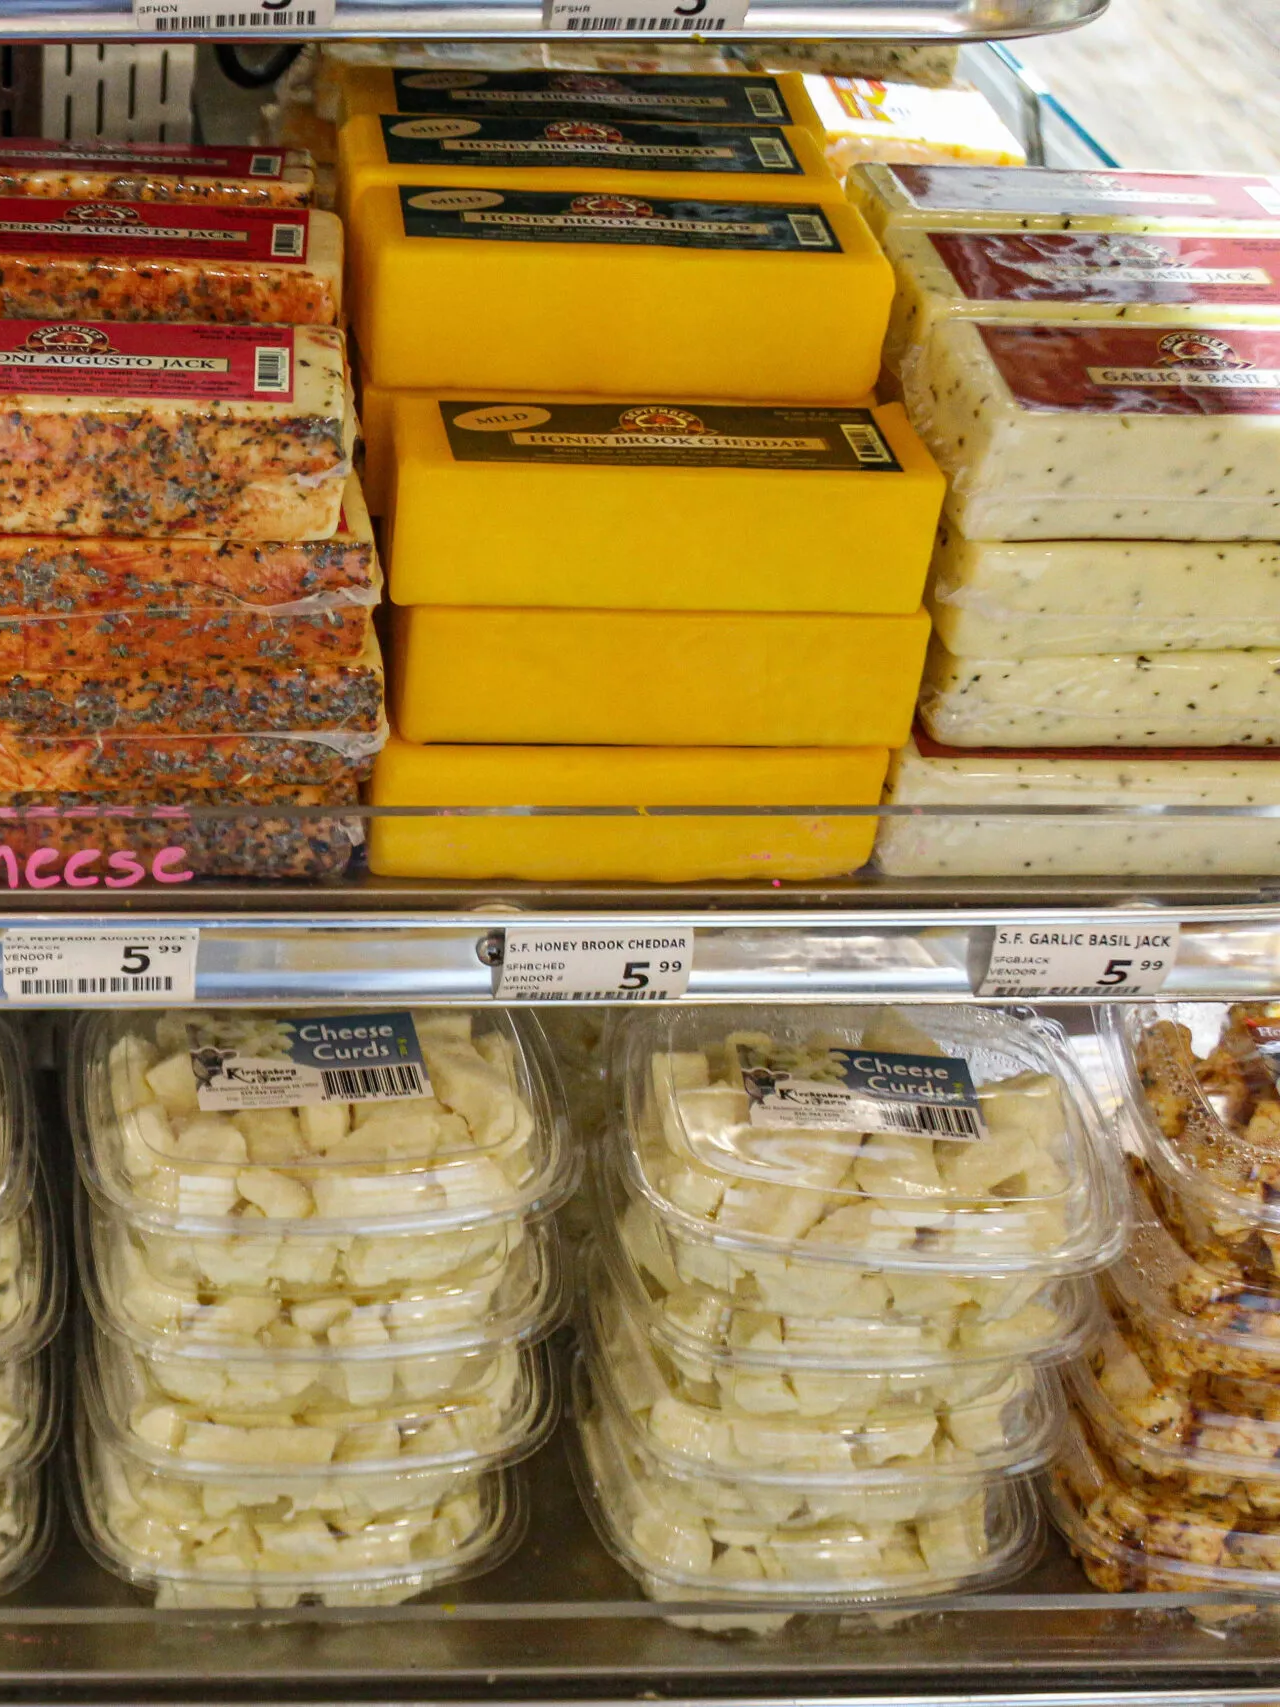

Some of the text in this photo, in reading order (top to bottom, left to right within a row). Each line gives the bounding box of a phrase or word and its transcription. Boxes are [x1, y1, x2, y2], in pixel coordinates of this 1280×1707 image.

[459, 141, 530, 150] HONEY
[537, 142, 609, 151] BROOK
[430, 196, 482, 206] MILD
[480, 214, 752, 233] HONEY BROOK CHEDDAR
[81, 226, 179, 237] AUGUSTO
[184, 230, 234, 239] JACK
[45, 354, 153, 367] AUGUSTO
[160, 358, 216, 370] JACK
[1102, 371, 1181, 383] GARLIC
[1206, 372, 1267, 385] BASIL
[476, 412, 529, 425] MILD
[528, 434, 808, 449] HONEY BROOK CHEDDAR
[535, 941, 578, 952] HONEY
[581, 940, 624, 951] BROOK
[628, 938, 686, 949] CHEDDAR
[1029, 933, 1084, 945] GARLIC
[1089, 934, 1131, 947] BASIL
[1134, 935, 1171, 949] JACK
[4, 953, 53, 961] VENDOR
[121, 945, 182, 975] 5 99
[5, 966, 38, 975] SFPEP
[506, 962, 566, 971] SFHBCHED
[989, 967, 1037, 976] VENDOR
[1096, 959, 1164, 986] 5 99
[504, 974, 553, 983] VENDOR
[618, 960, 682, 991] 5 99
[299, 1023, 394, 1042] Cheese
[313, 1040, 391, 1060] Curds
[853, 1057, 949, 1080] Cheese
[867, 1075, 945, 1097] Curds
